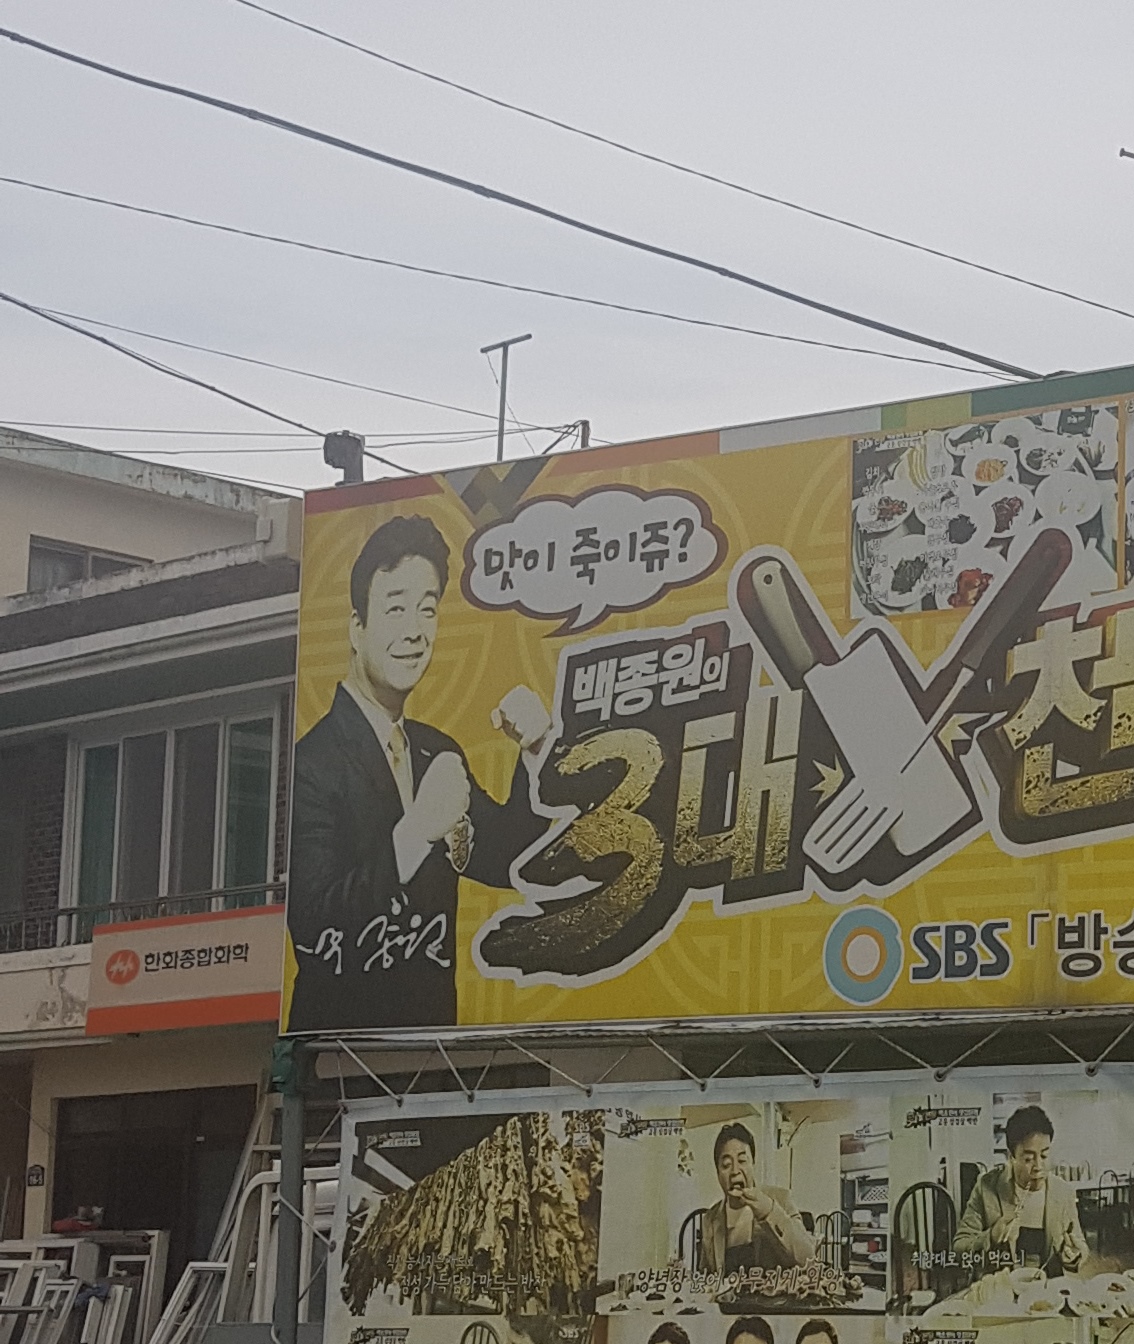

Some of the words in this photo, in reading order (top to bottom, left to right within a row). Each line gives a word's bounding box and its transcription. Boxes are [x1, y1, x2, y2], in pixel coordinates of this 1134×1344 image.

[484, 541, 556, 591] 맛이
[570, 518, 695, 586] 죽이쥬?
[572, 636, 731, 721] 백종원의
[144, 942, 250, 973] 한화종합화학
[909, 920, 1011, 983] SBS
[911, 1249, 960, 1271] 취향대로
[988, 1248, 1026, 1269] 먹으니
[423, 1272, 451, 1295] 가득
[452, 1272, 478, 1295] 담아
[478, 1272, 520, 1295] 만드는
[521, 1273, 547, 1295] 반찬
[638, 1267, 688, 1294] 양념장
[690, 1268, 724, 1294] 얹어
